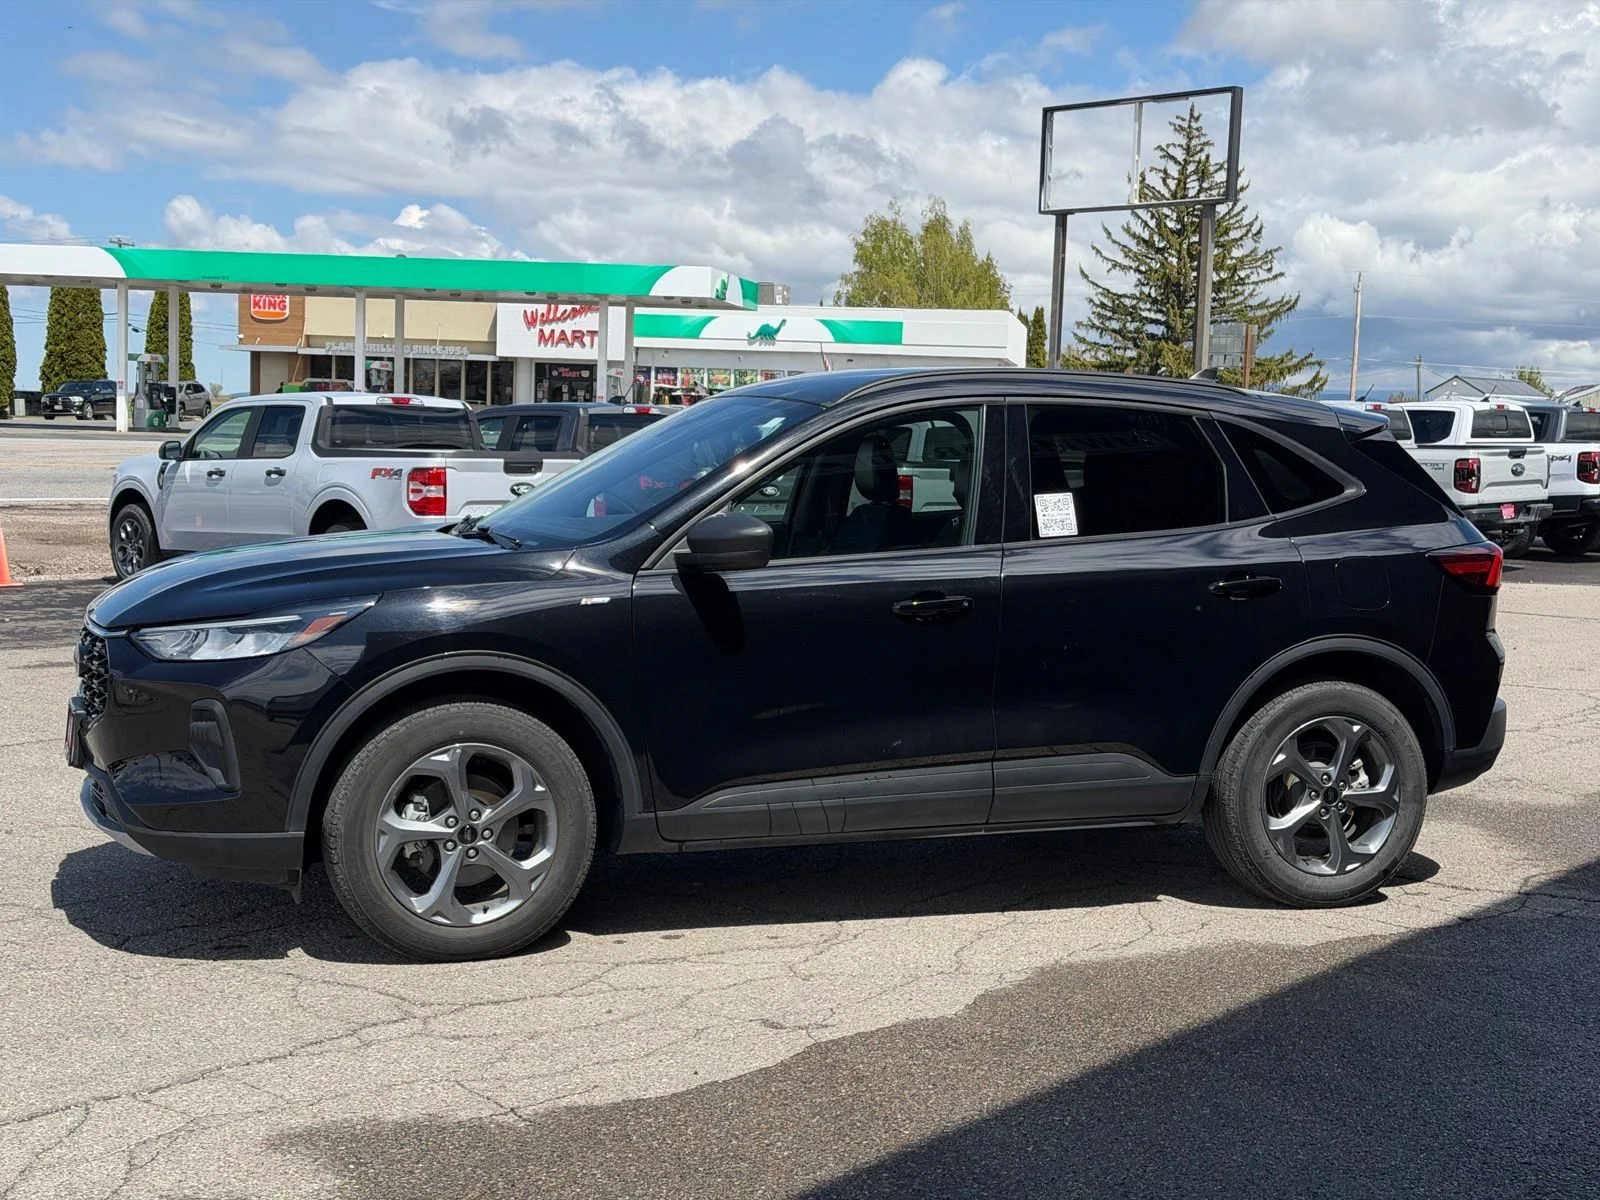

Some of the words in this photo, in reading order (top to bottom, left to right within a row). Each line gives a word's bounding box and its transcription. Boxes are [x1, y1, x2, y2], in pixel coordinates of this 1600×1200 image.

[252, 299, 287, 311] KING
[523, 303, 600, 331] Wellcom
[538, 328, 599, 349] MART
[325, 342, 355, 352] FLAM
[412, 345, 443, 355] SINCE
[443, 346, 469, 356] 1954
[371, 467, 403, 479] FX4
